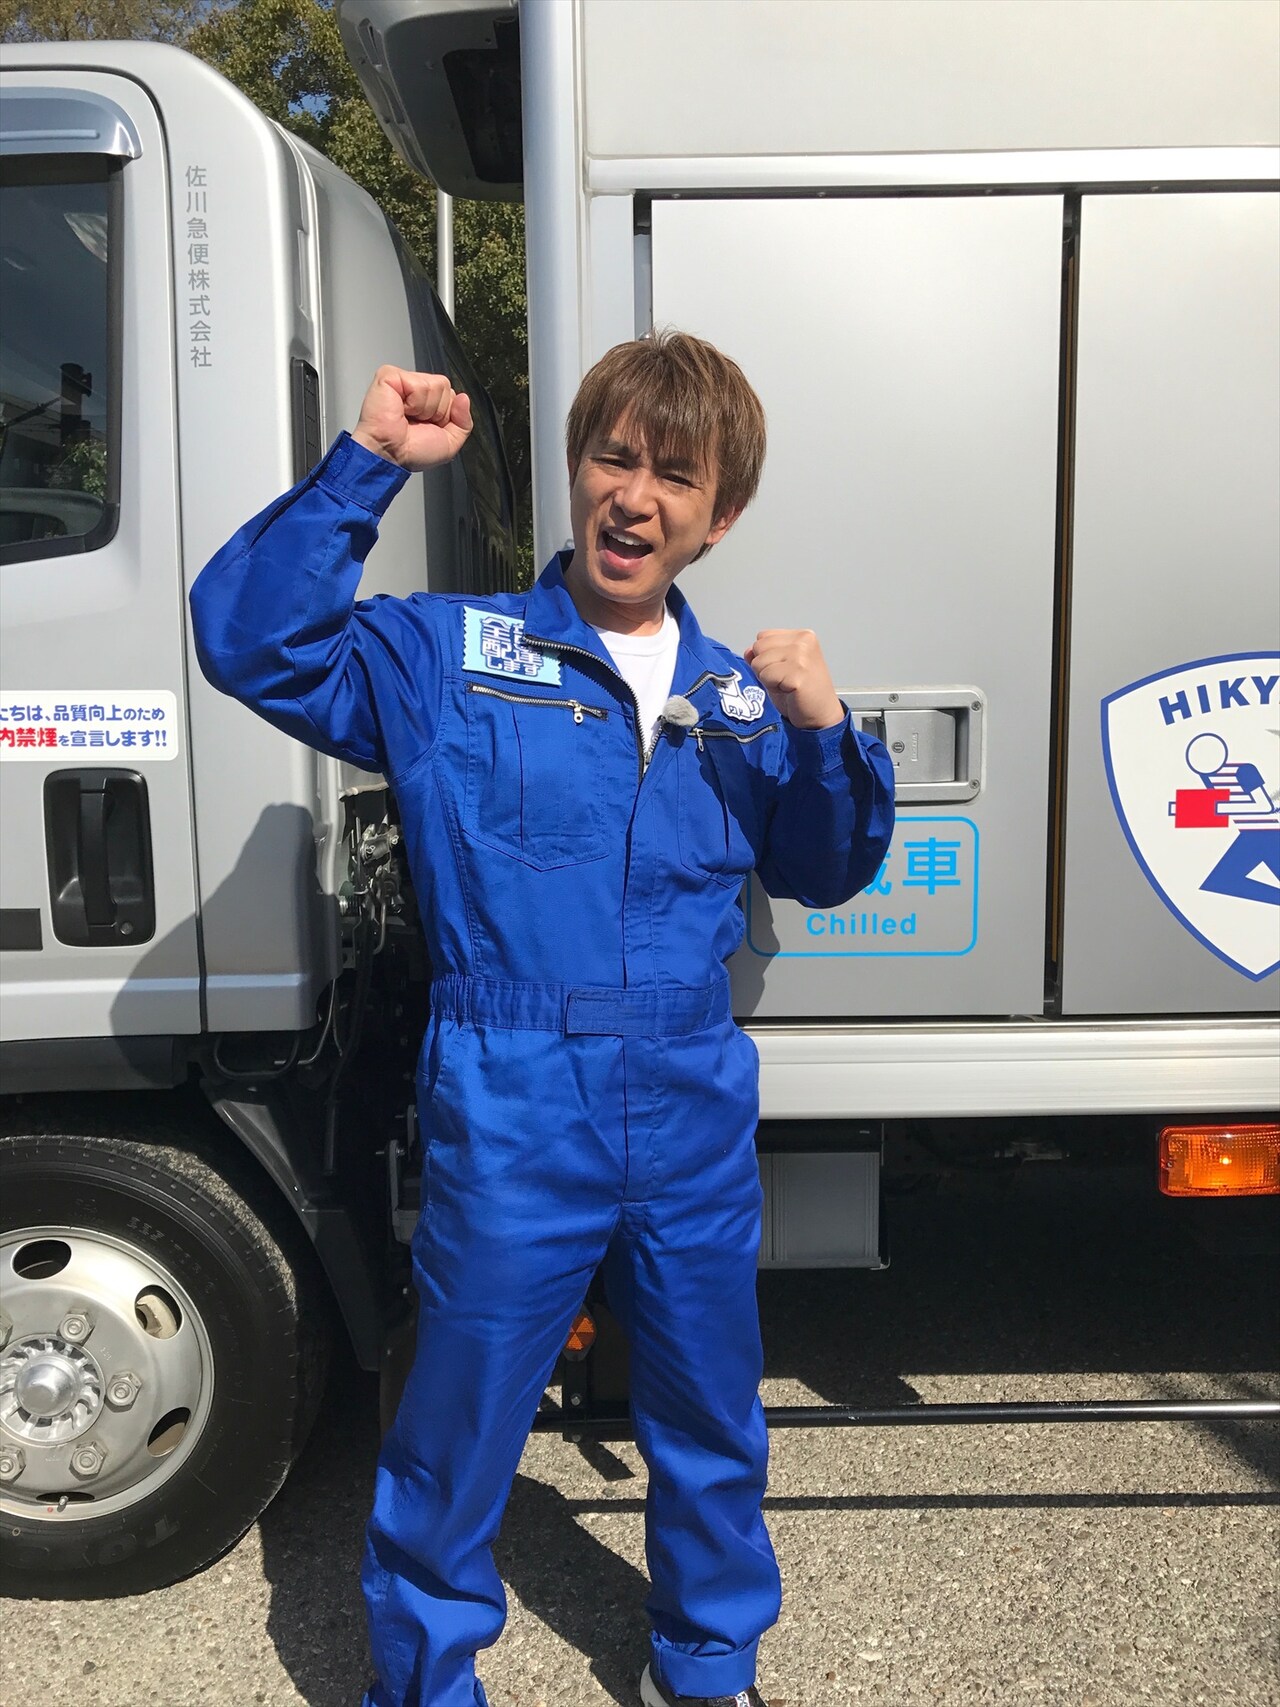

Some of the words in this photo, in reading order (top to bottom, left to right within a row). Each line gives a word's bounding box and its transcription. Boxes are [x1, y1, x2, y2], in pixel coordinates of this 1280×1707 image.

[185, 165, 212, 368] 佐川急便株式会社
[481, 639, 544, 667] 配達
[486, 655, 538, 677] します
[1158, 675, 1280, 726] HIKY
[806, 912, 917, 936] Chilled
